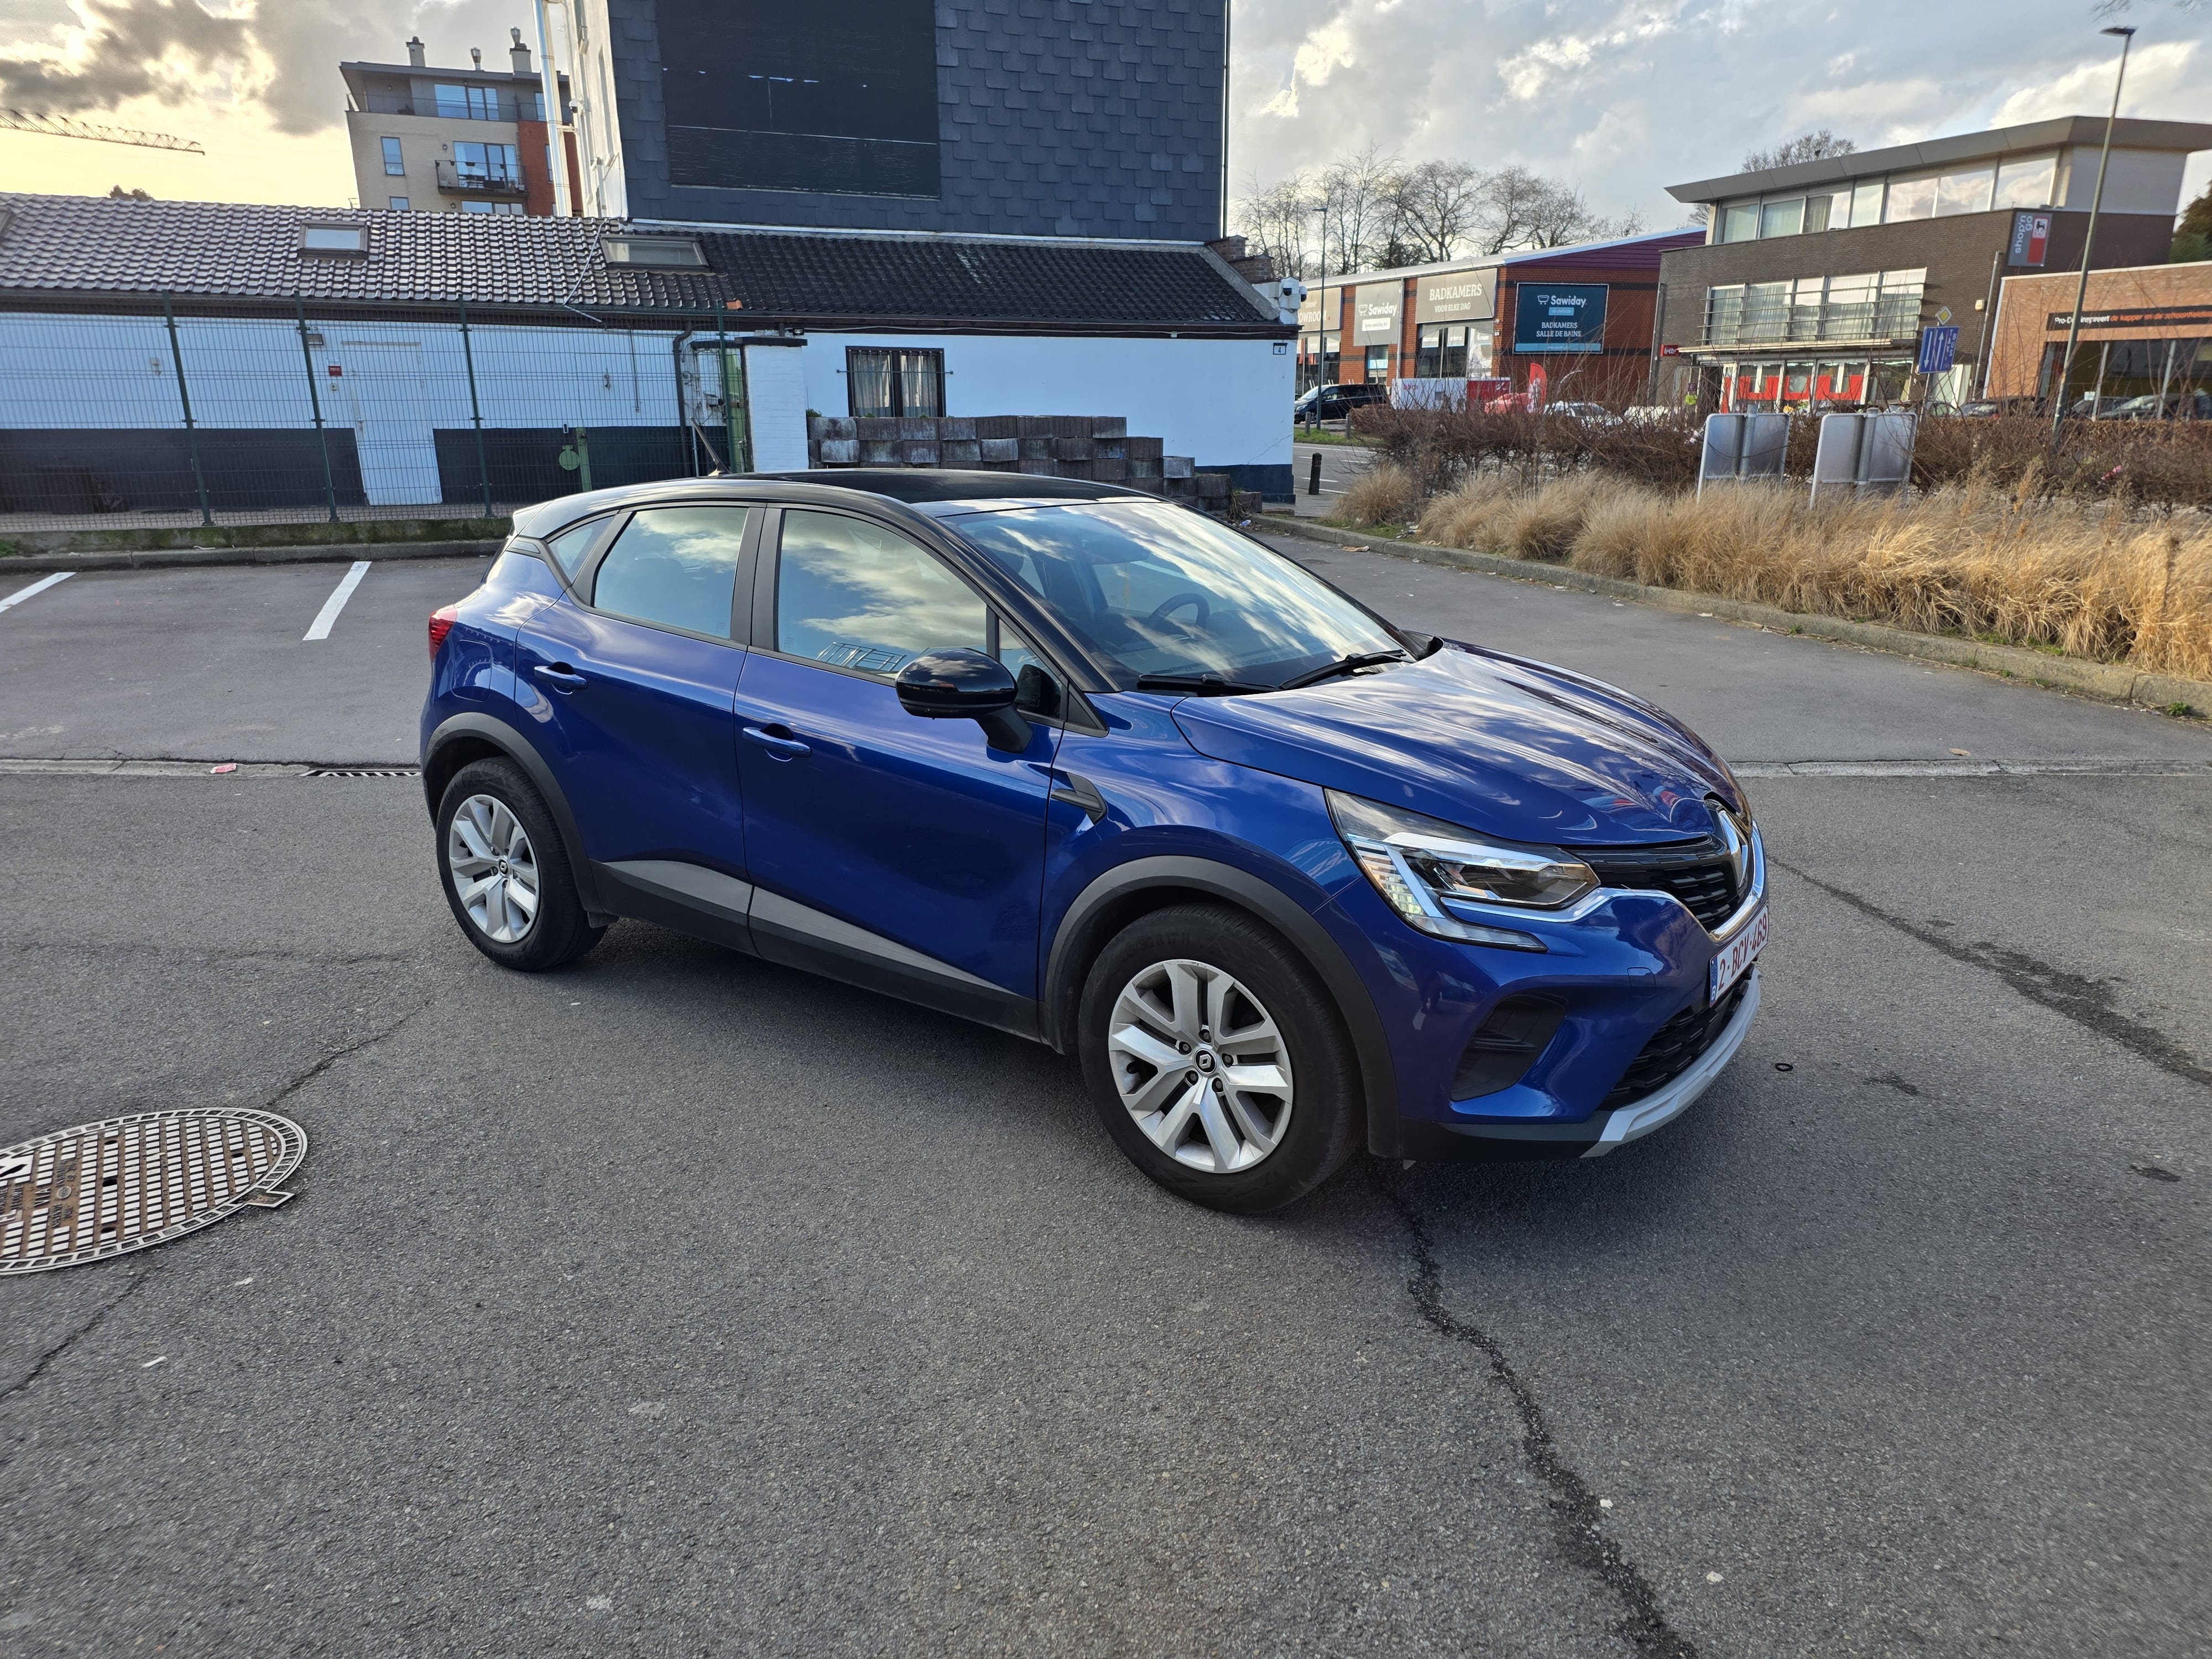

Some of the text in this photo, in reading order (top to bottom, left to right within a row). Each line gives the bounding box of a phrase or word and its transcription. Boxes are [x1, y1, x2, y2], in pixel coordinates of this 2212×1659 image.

[2025, 216, 2033, 231] go
[1429, 283, 1482, 301] BADKAMERS
[1434, 305, 1448, 313] VOOR
[1460, 302, 1471, 310] DAG
[1551, 295, 1587, 308] Sawiday
[1298, 310, 1327, 323] OWROO
[1368, 302, 1397, 317] Sawiday
[1711, 985, 1717, 1001] B
[34, 1187, 51, 1207] VIA
